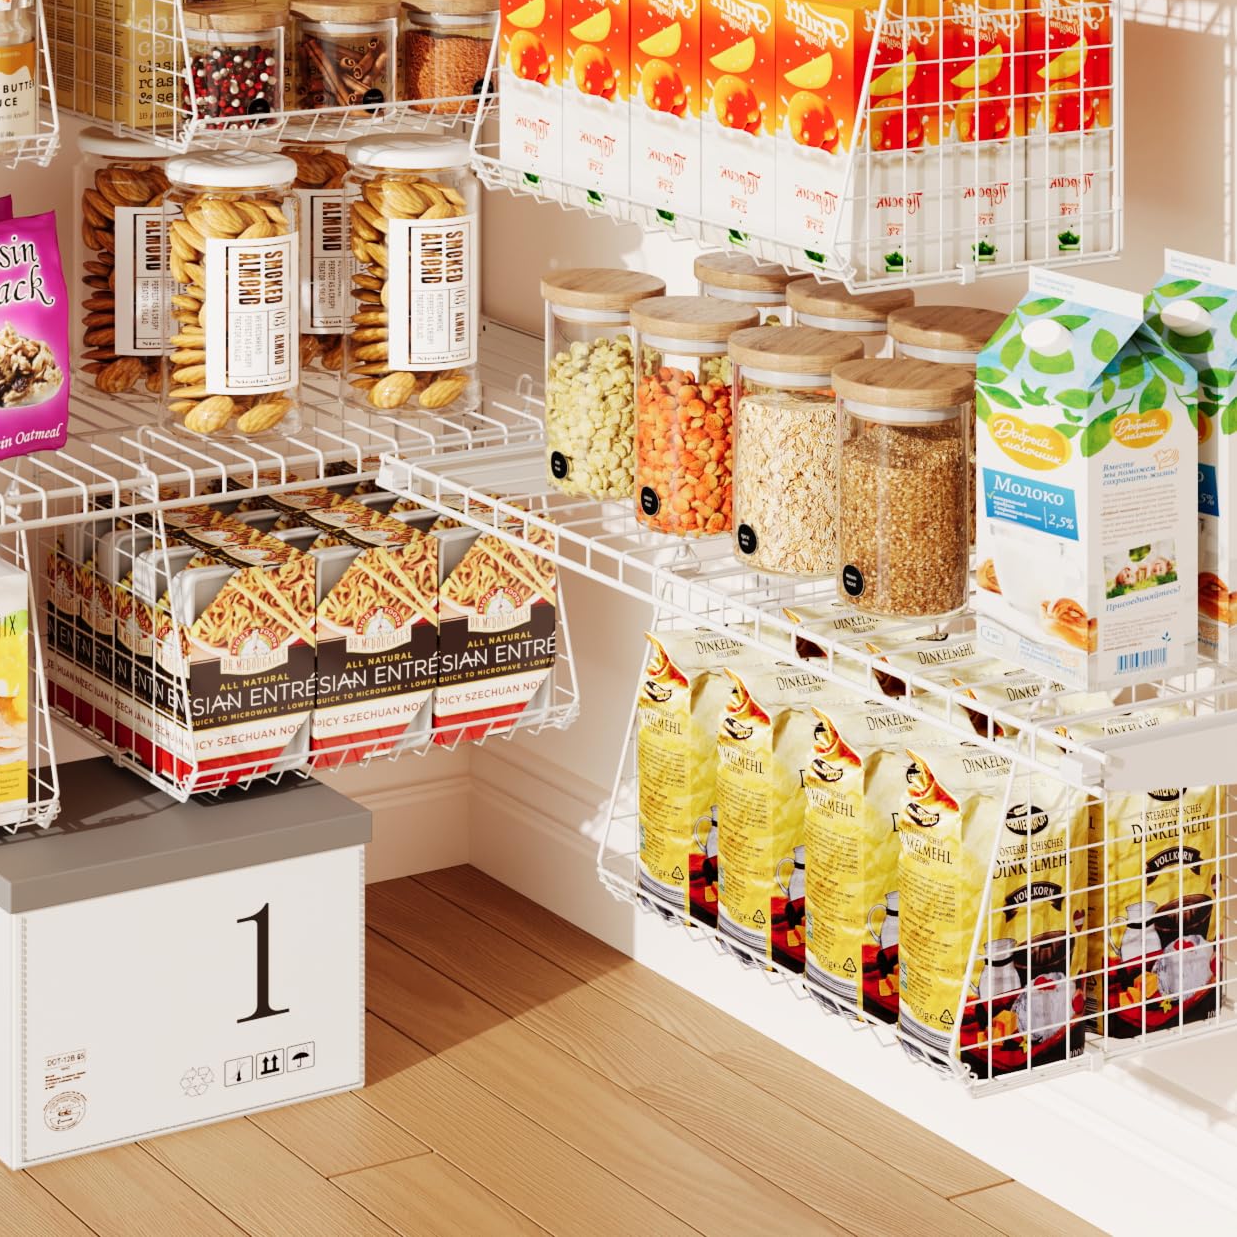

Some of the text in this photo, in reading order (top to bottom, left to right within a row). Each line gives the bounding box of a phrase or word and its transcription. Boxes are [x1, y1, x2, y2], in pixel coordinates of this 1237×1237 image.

[420, 232, 443, 284] ALMOND
[446, 229, 464, 283] SMOKED
[238, 252, 261, 306] ALMOND
[265, 250, 283, 304] SMOKED
[454, 312, 464, 343] ALMOND
[15, 423, 63, 447] Oatmeal
[994, 474, 1064, 506] Молоко
[1048, 513, 1074, 530] 2,5%
[467, 631, 532, 648] ALL NATURAL
[345, 651, 413, 669] ALL NATURAL
[356, 684, 402, 698] MICROWAVE
[465, 686, 519, 703] SZECHUAN
[343, 706, 400, 723] SZECHUAN
[236, 902, 290, 1024] 1
